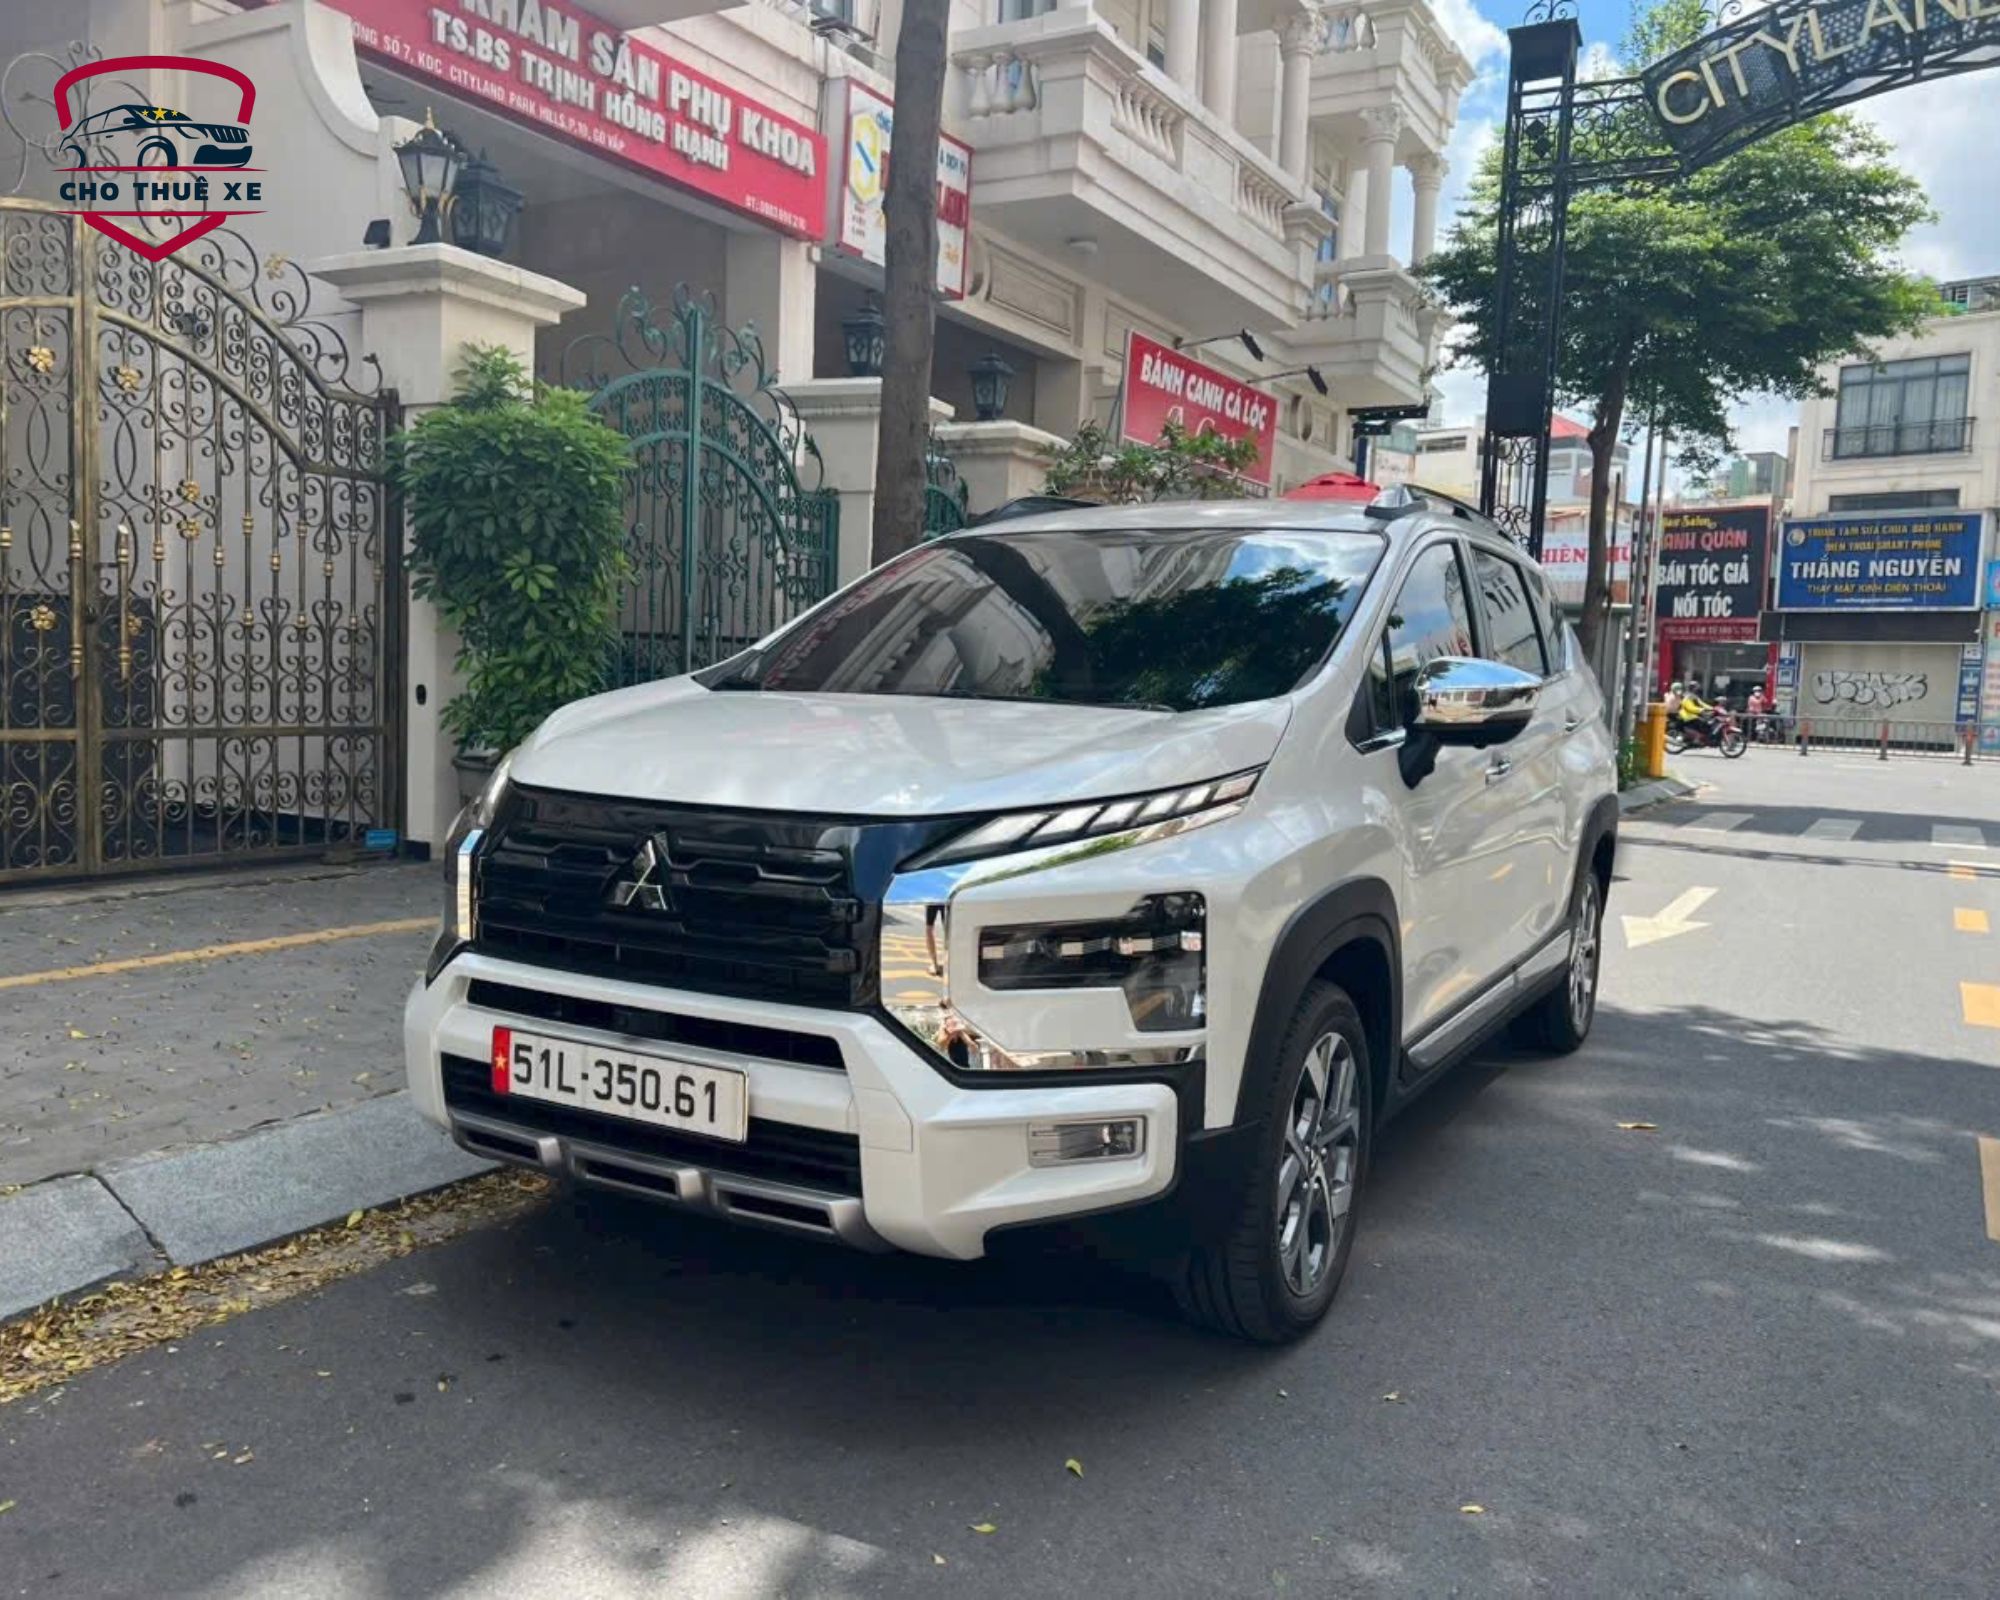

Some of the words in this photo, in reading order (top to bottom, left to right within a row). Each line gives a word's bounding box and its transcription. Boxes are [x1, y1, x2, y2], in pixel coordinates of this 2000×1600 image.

[430, 8, 511, 71] TS.BS
[521, 51, 595, 111] TRỊNH
[674, 122, 729, 171] HẠNH
[449, 67, 505, 101] CITYLAND
[669, 70, 732, 139] PHỤ
[740, 107, 816, 177] KHOA
[1140, 350, 1186, 396] BÁNH
[1186, 374, 1225, 413] CANH
[1225, 387, 1242, 421] CÁ
[1701, 528, 1748, 551] QUÂN
[1658, 559, 1686, 586] BÁN
[1689, 557, 1719, 585] TÓC
[1723, 553, 1749, 585] GIẢ
[1790, 553, 1860, 579] THẮNG
[1869, 551, 1962, 578] NGUYỄN
[1672, 591, 1698, 618] NỐI
[1702, 590, 1733, 617] TÓC
[514, 1043, 716, 1123] 51L-350.61
